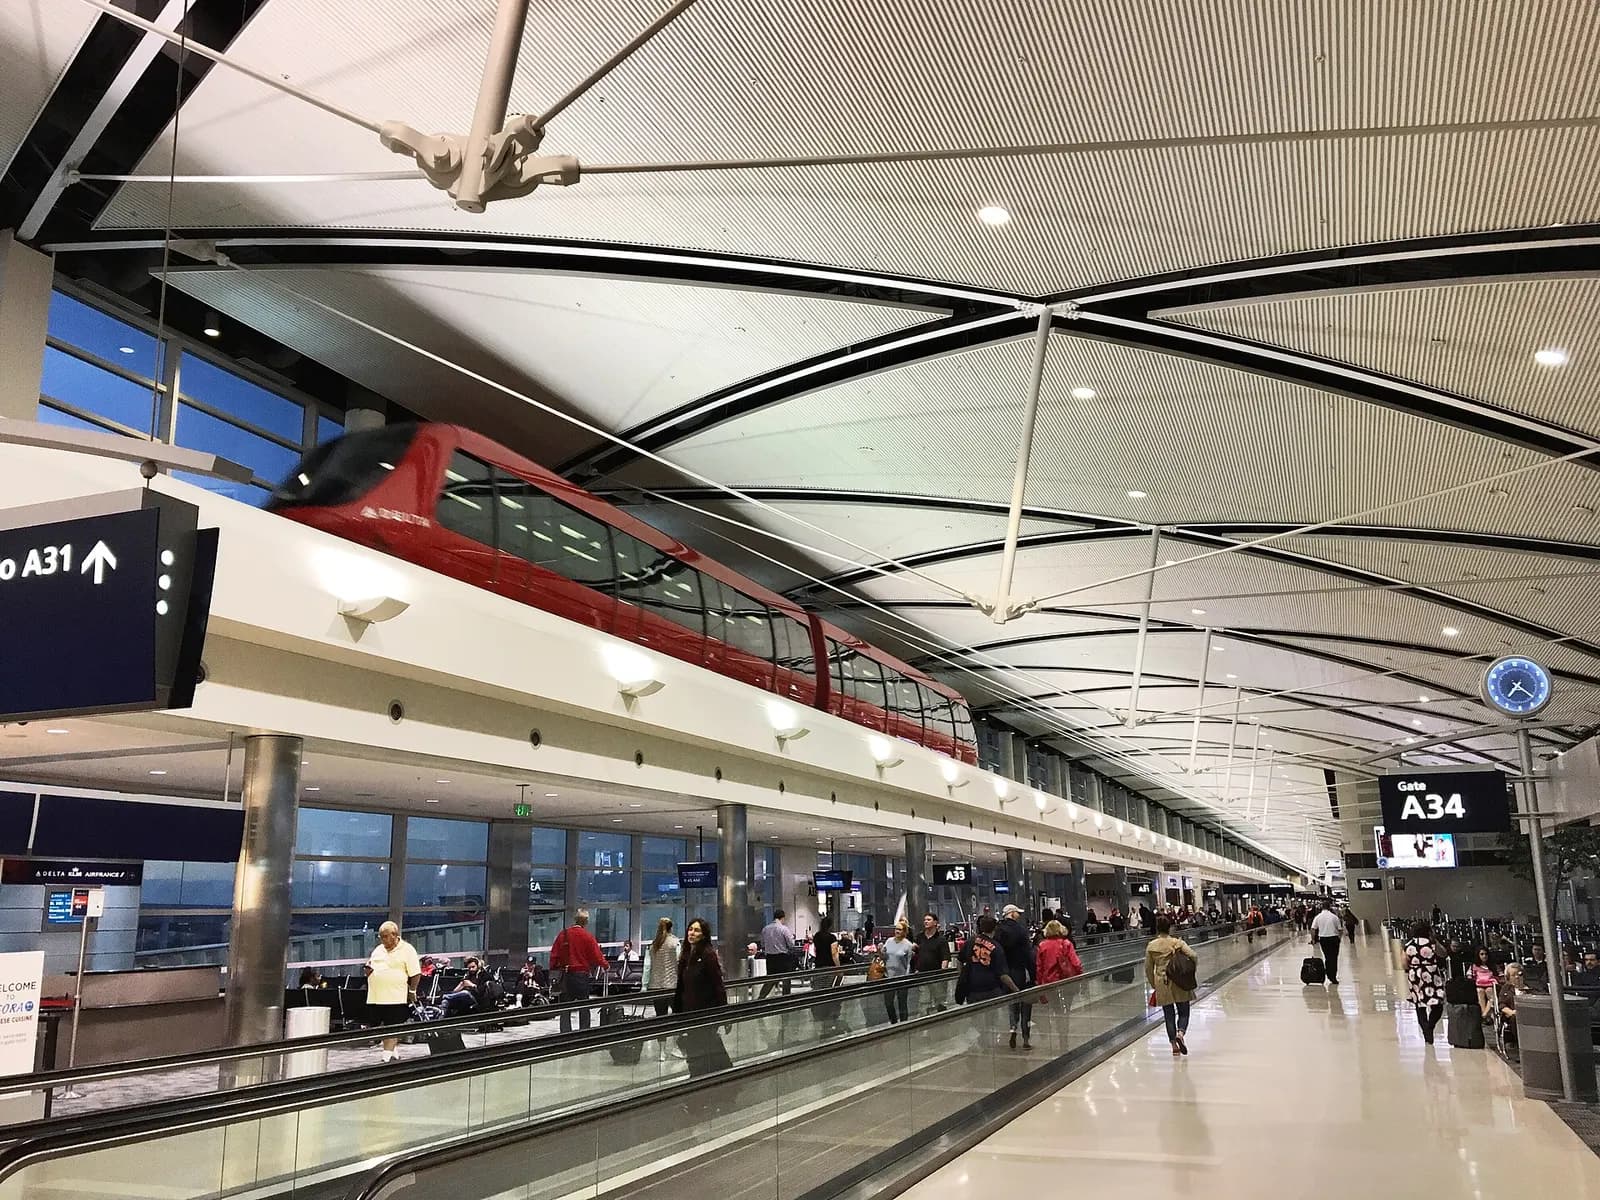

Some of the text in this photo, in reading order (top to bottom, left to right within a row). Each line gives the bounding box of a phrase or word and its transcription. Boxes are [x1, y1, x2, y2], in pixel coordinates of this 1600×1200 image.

[21, 543, 72, 578] A31
[1397, 781, 1427, 792] Gate
[1400, 793, 1466, 820] A34
[946, 870, 965, 881] A33
[0, 1002, 24, 1014] ORA
